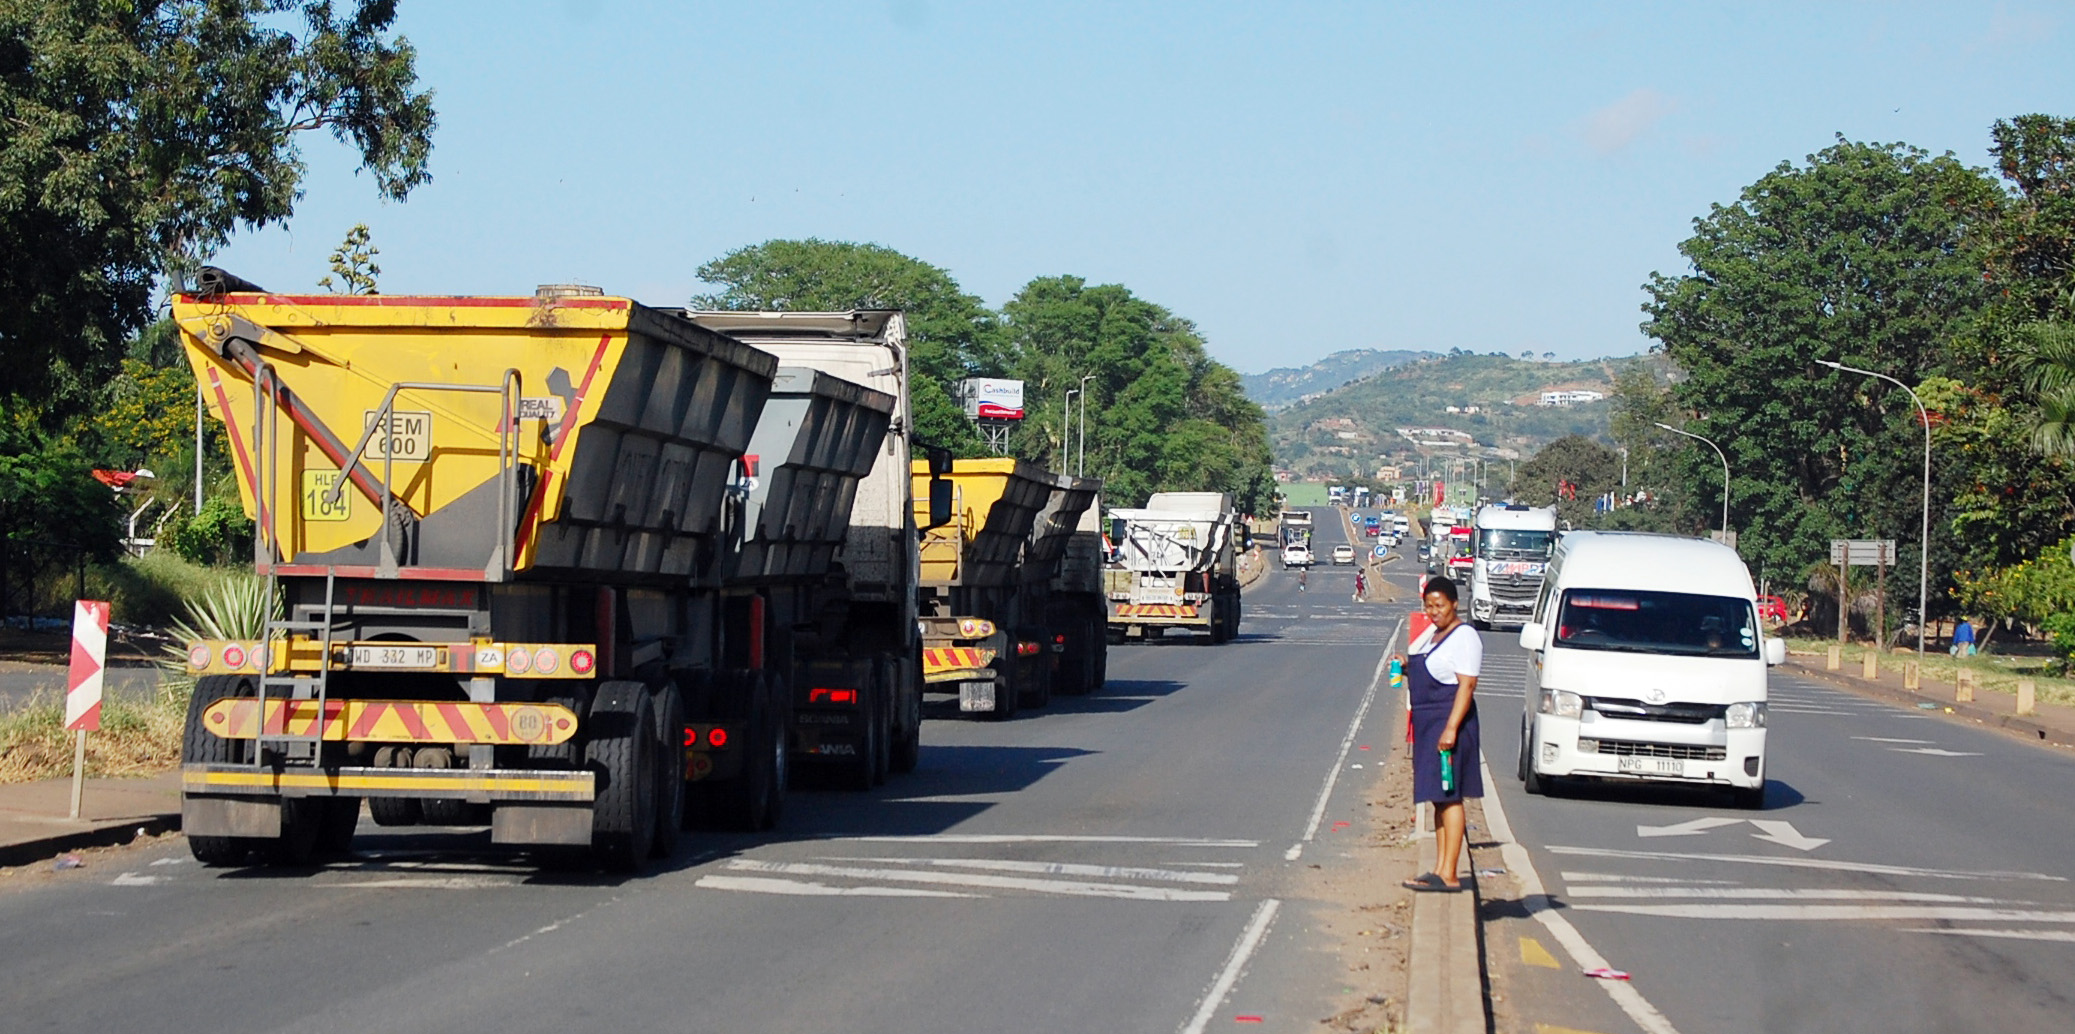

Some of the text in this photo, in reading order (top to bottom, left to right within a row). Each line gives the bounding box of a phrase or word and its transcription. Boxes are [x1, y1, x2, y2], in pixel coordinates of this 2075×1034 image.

[983, 384, 1020, 395] Cashbuild
[520, 400, 553, 410] REAL
[374, 418, 422, 435] REM
[379, 437, 416, 455] 600
[307, 489, 346, 515] 184
[345, 588, 475, 606] TRAILMAX
[417, 651, 433, 663] MP
[481, 653, 498, 663] ZA
[1620, 759, 1682, 772] NPG 11110
